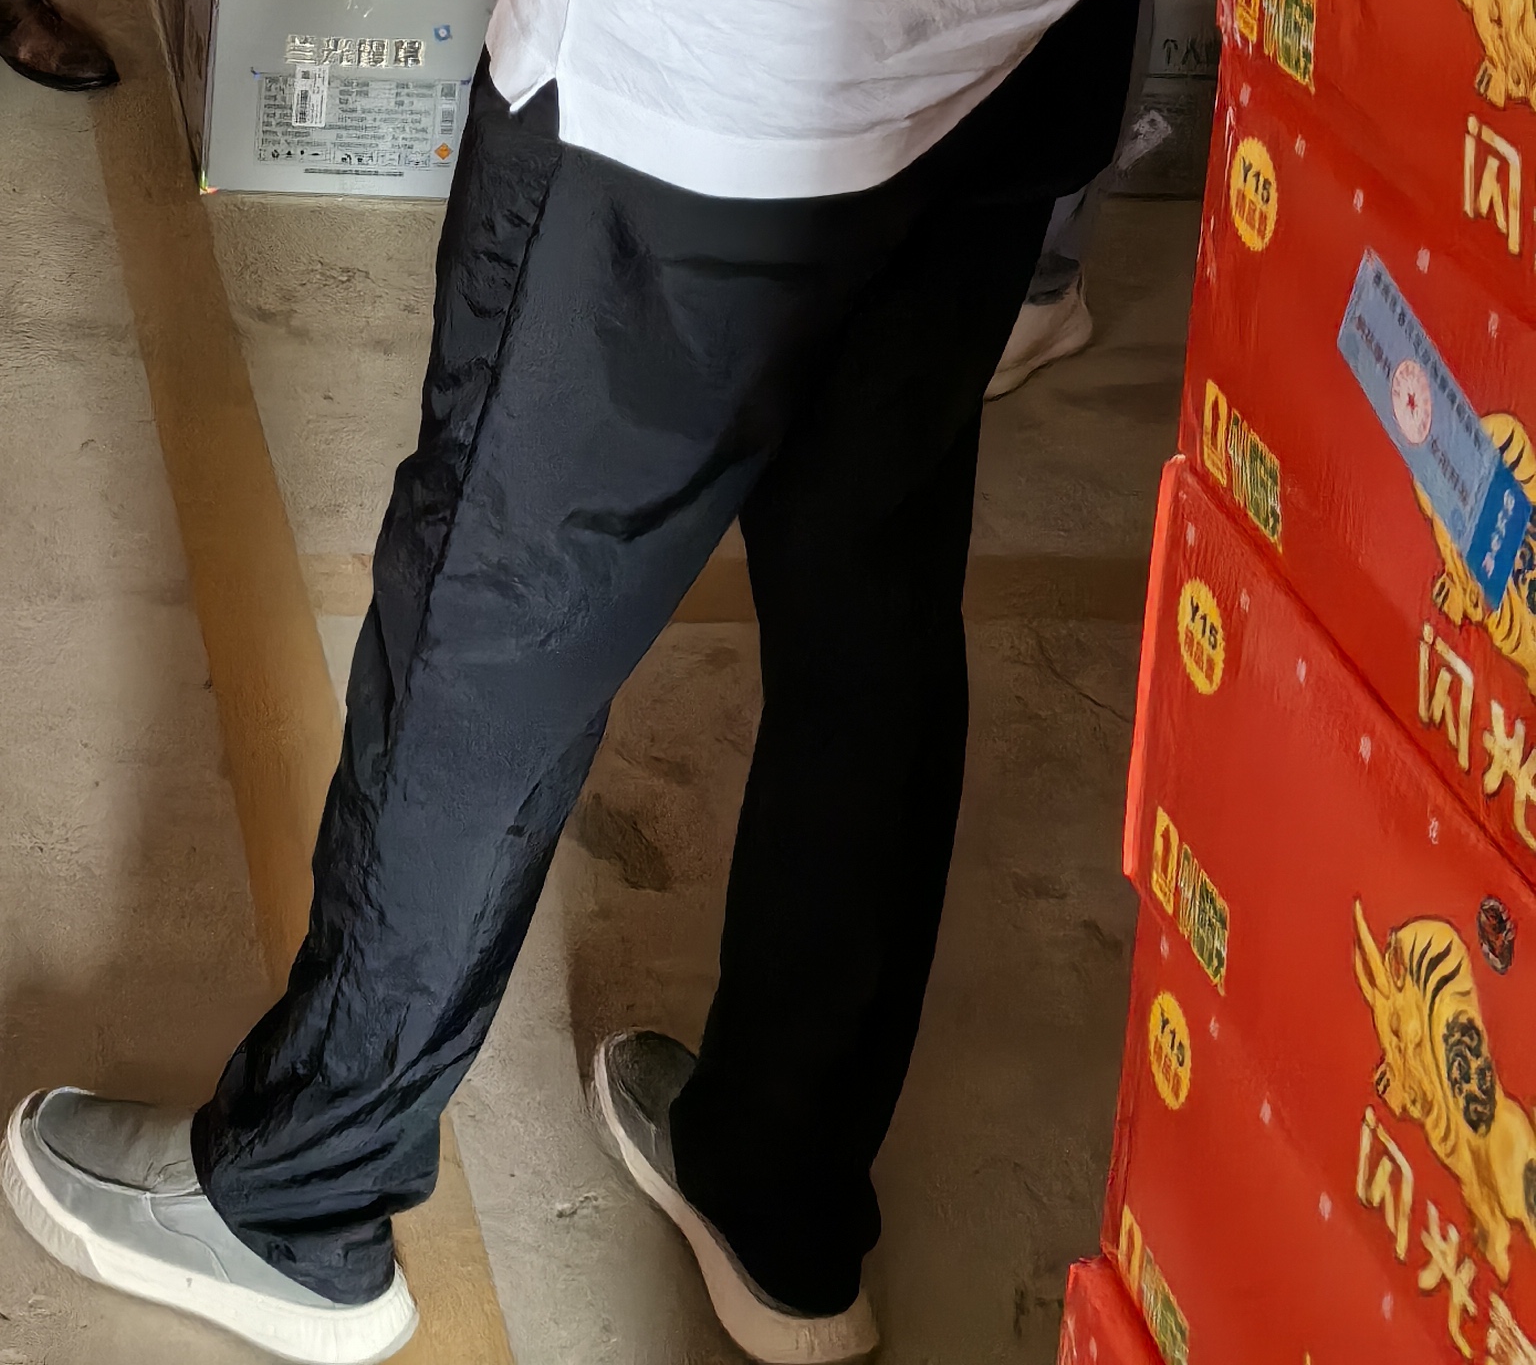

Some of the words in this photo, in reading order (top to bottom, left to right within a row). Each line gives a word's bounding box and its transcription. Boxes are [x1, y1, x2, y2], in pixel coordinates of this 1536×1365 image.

[1241, 155, 1272, 206] Y15
[1462, 112, 1536, 257] 闪
[1189, 595, 1219, 652] Y15
